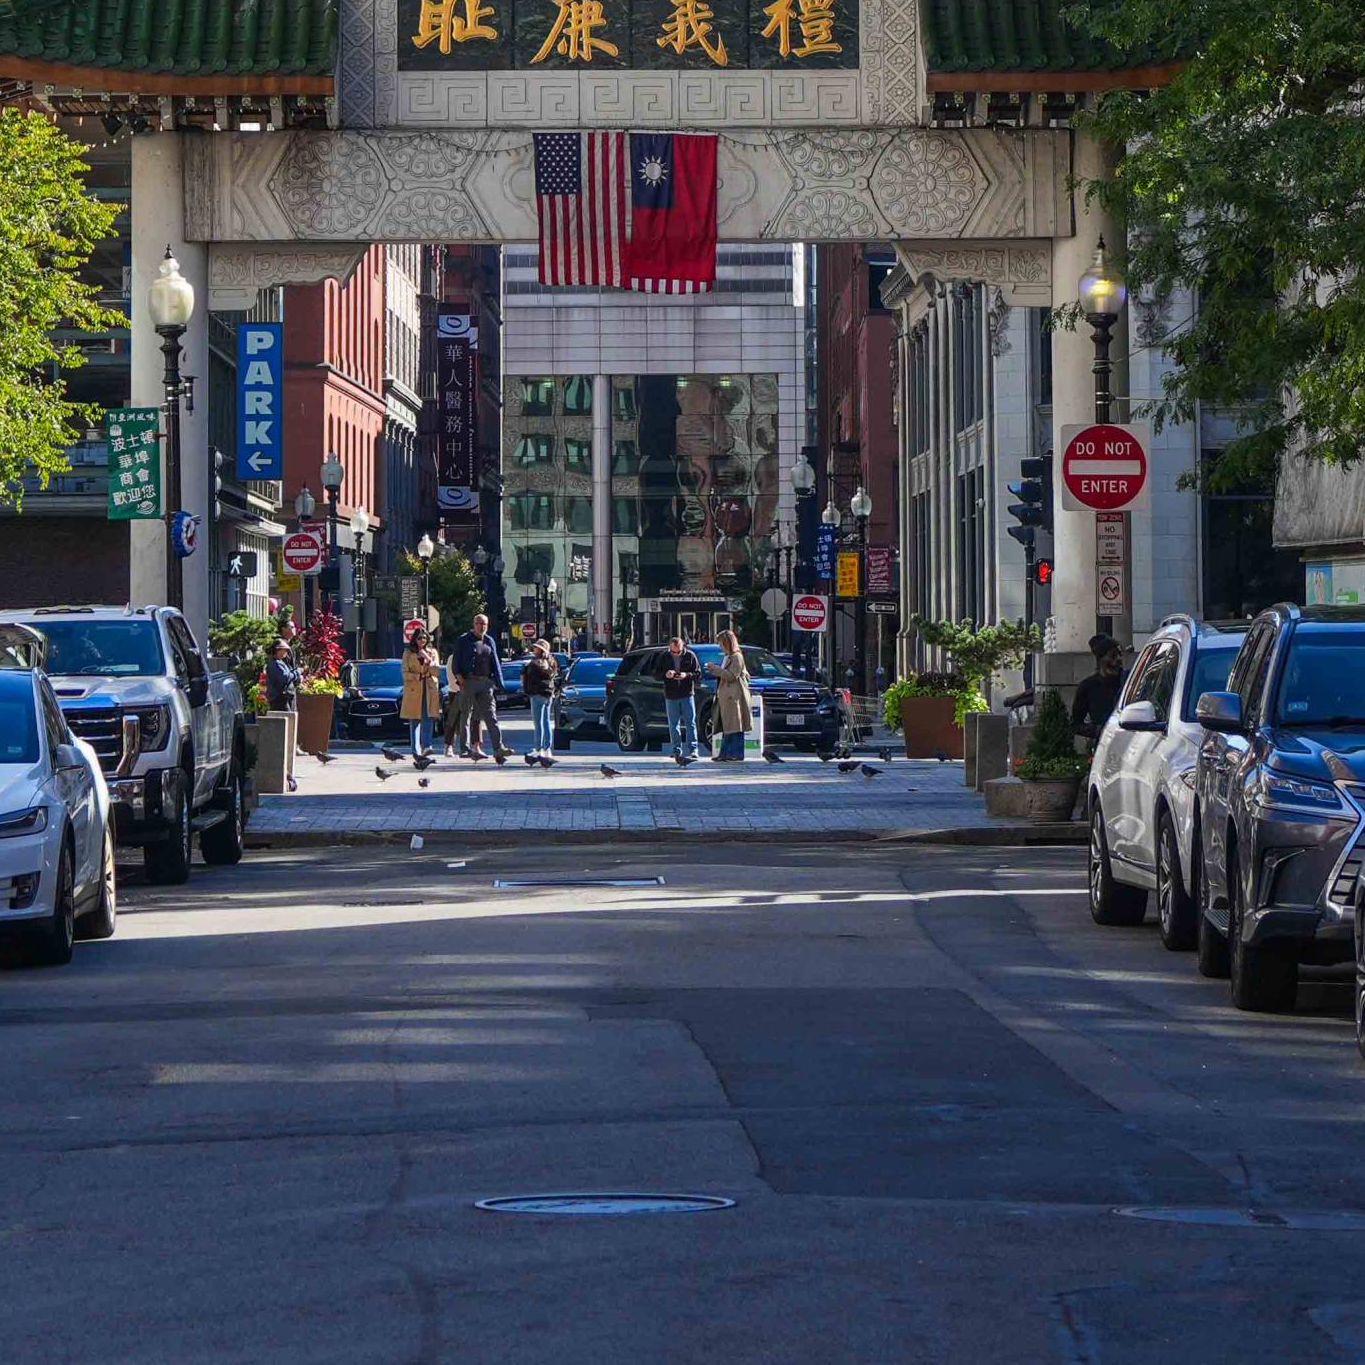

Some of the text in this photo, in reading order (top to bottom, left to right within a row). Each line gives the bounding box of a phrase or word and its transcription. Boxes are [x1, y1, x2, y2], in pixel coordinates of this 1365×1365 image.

[243, 331, 275, 445] PARK
[445, 345, 464, 480] 華人醫務中心
[111, 429, 155, 452] 波士頓
[1076, 442, 1132, 456] DO NOT
[1081, 480, 1128, 494] ENTER
